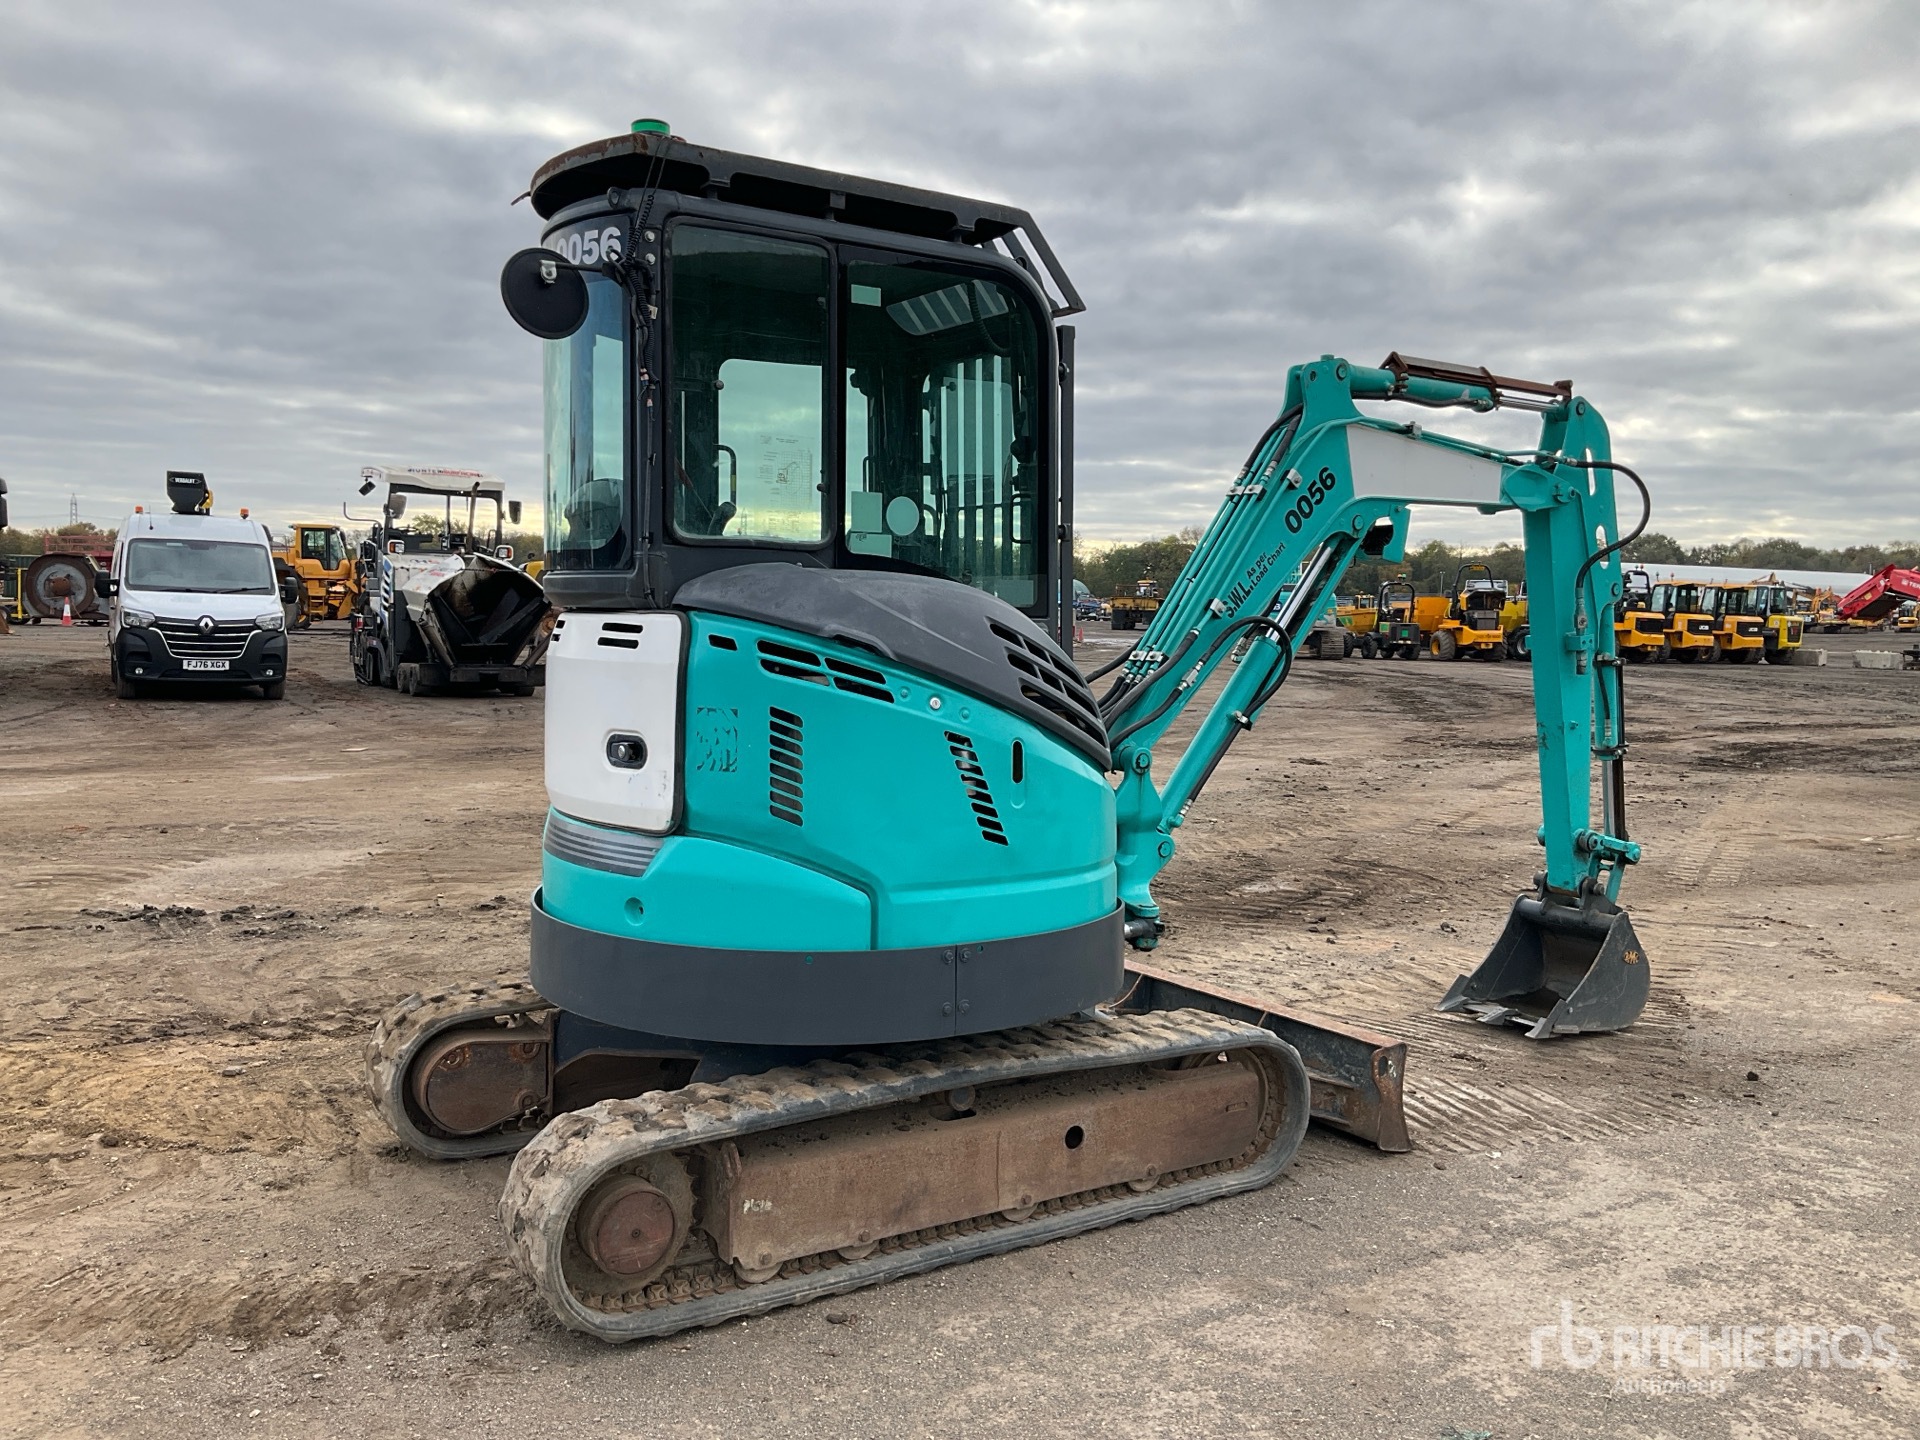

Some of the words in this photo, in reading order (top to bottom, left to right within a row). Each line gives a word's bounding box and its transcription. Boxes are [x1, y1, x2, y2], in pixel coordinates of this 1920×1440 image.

[557, 226, 622, 265] 0056
[1285, 466, 1336, 534] 0056
[1246, 567, 1257, 579] As
[1255, 552, 1268, 570] per
[1250, 564, 1269, 587] Load
[1266, 542, 1286, 566] Chart
[187, 660, 208, 669] FJ76
[210, 661, 226, 669] XGX
